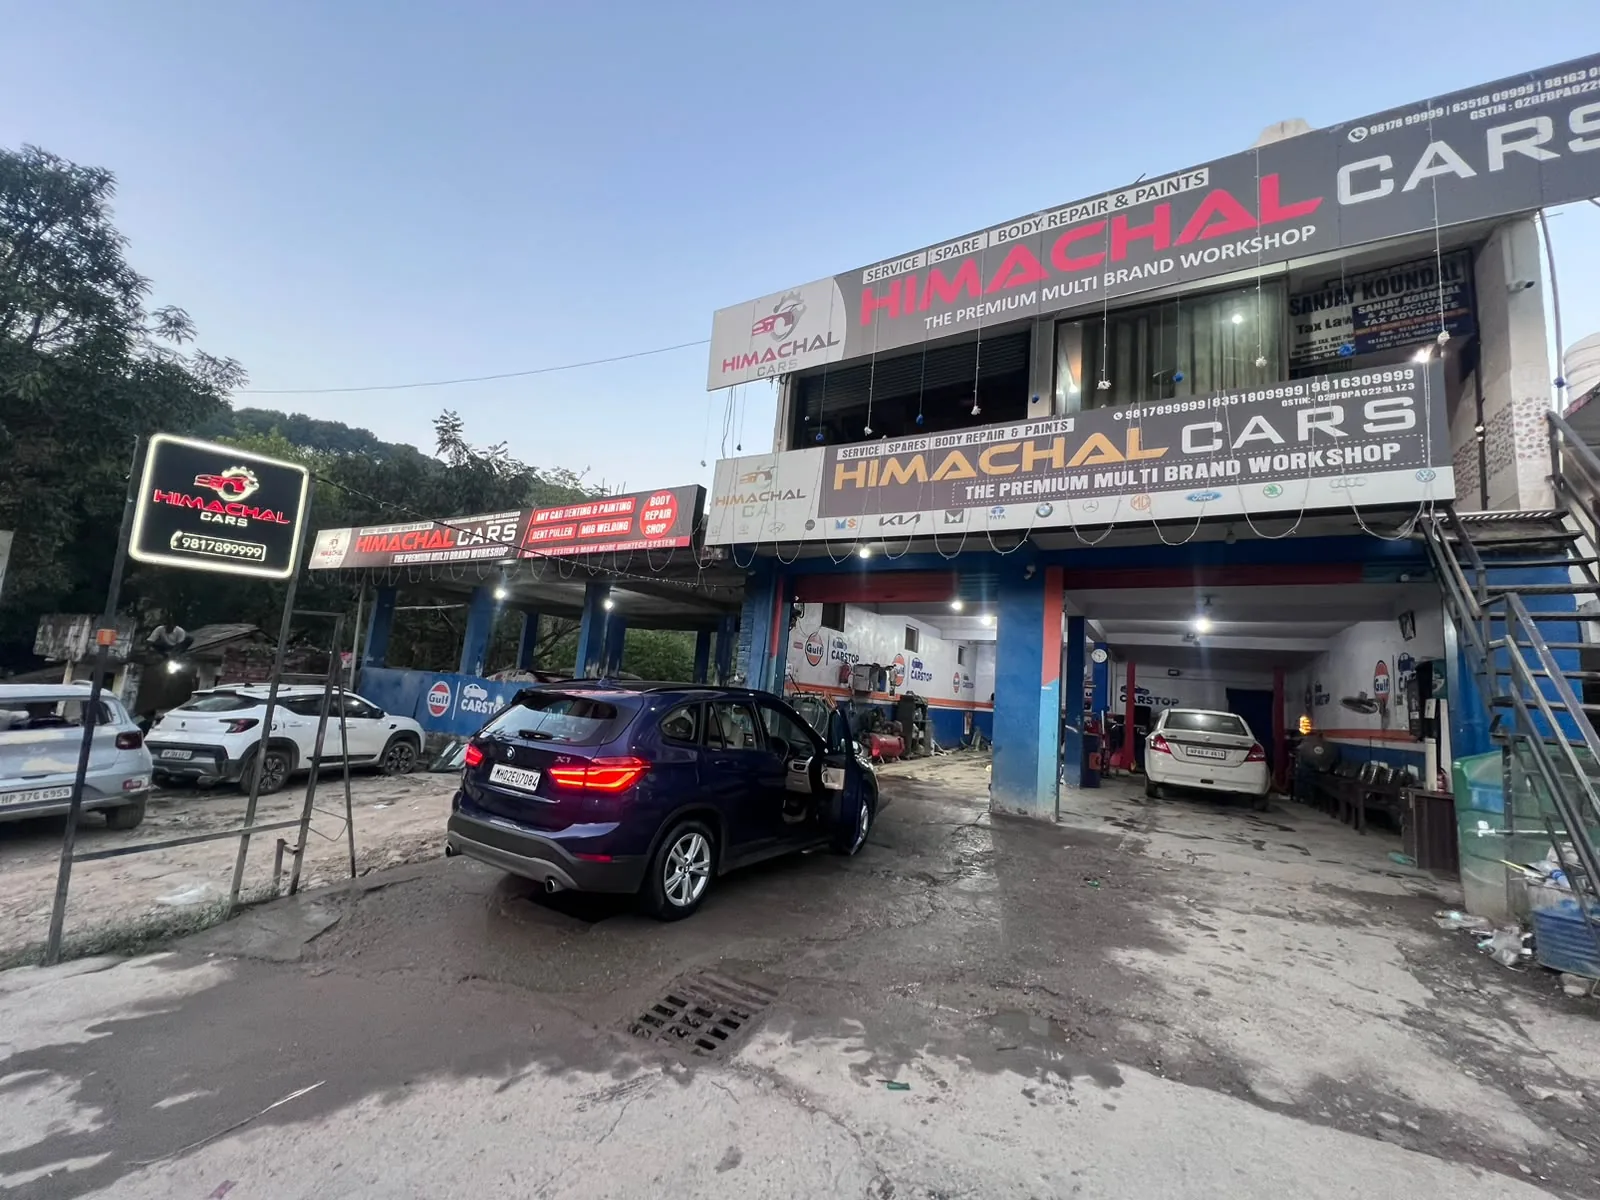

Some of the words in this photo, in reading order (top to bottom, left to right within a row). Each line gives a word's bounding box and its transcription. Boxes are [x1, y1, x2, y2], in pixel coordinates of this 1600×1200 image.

[1369, 118, 1403, 135] 98178
[1405, 107, 1444, 125] 99999
[1452, 95, 1490, 113] 83518
[1492, 83, 1534, 103] 09999
[1544, 70, 1586, 89] 98163
[1588, 66, 1600, 78] 0
[1470, 103, 1506, 120] GSTIN
[1514, 79, 1600, 109] 02BFDPA022
[866, 256, 919, 282] SERVICE
[934, 237, 979, 261] SPARE
[998, 218, 1042, 242] BODY
[1047, 201, 1108, 228] REPAIR
[1114, 194, 1129, 208] &
[1135, 171, 1205, 202] PAINTS
[860, 173, 1324, 327] HIMACHAL
[924, 315, 952, 330] THE
[956, 291, 1036, 323] PREMIUM
[1042, 275, 1098, 301] MULTI
[1103, 258, 1174, 286] BRAND
[1180, 225, 1316, 269] WORKSHOP
[1290, 285, 1356, 316] SANJAY
[1357, 299, 1401, 314] SANJAY
[1363, 317, 1387, 327] TAX
[1390, 301, 1459, 321] ADVOCATE
[1296, 322, 1322, 334] Tax
[722, 331, 840, 373] HIMACHAL
[757, 358, 798, 377] CARS
[1125, 401, 1206, 420] 9817899999
[1212, 385, 1303, 407] 8351809999
[1311, 369, 1414, 393] 9816309999
[833, 428, 1169, 490] HIMACHAL
[1182, 397, 1416, 454] CARS
[842, 445, 880, 458] SERVICE
[887, 439, 927, 453] SPARES
[934, 434, 963, 448] BODY
[965, 430, 1005, 444] REPAIR
[1011, 428, 1018, 438] &
[1025, 420, 1068, 436] PAINTS
[965, 485, 995, 500] THE
[999, 475, 1088, 498] PREMIUM
[1094, 467, 1158, 489] MULTI
[1164, 459, 1241, 482] BRAND
[1248, 443, 1400, 474] WORKSHOP
[153, 488, 290, 524] HIMACHAL
[650, 494, 671, 507] BODY
[715, 488, 806, 507] HIMACHAL
[200, 511, 248, 527] CARS
[536, 510, 549, 521] ANY
[550, 509, 562, 520] CAR
[599, 501, 631, 513] PAINTING
[644, 508, 672, 521] REPAIR
[355, 528, 454, 552] HIMACHAL
[457, 523, 517, 546] CARS
[532, 528, 548, 540] DENT
[548, 526, 573, 538] PULLER
[598, 520, 628, 533] WELDING
[646, 523, 666, 535] SHOP
[181, 537, 262, 557] 9817899999
[471, 547, 509, 558] WORKSHOP
[648, 538, 676, 548] SYSTEM
[807, 643, 822, 655] Gulf
[831, 649, 860, 664] CARSTOP
[911, 669, 933, 682] CARSTOP
[1375, 678, 1389, 692] Gulf
[429, 693, 449, 705] Gulf
[461, 698, 503, 715] CARSTO
[555, 755, 571, 764] X1
